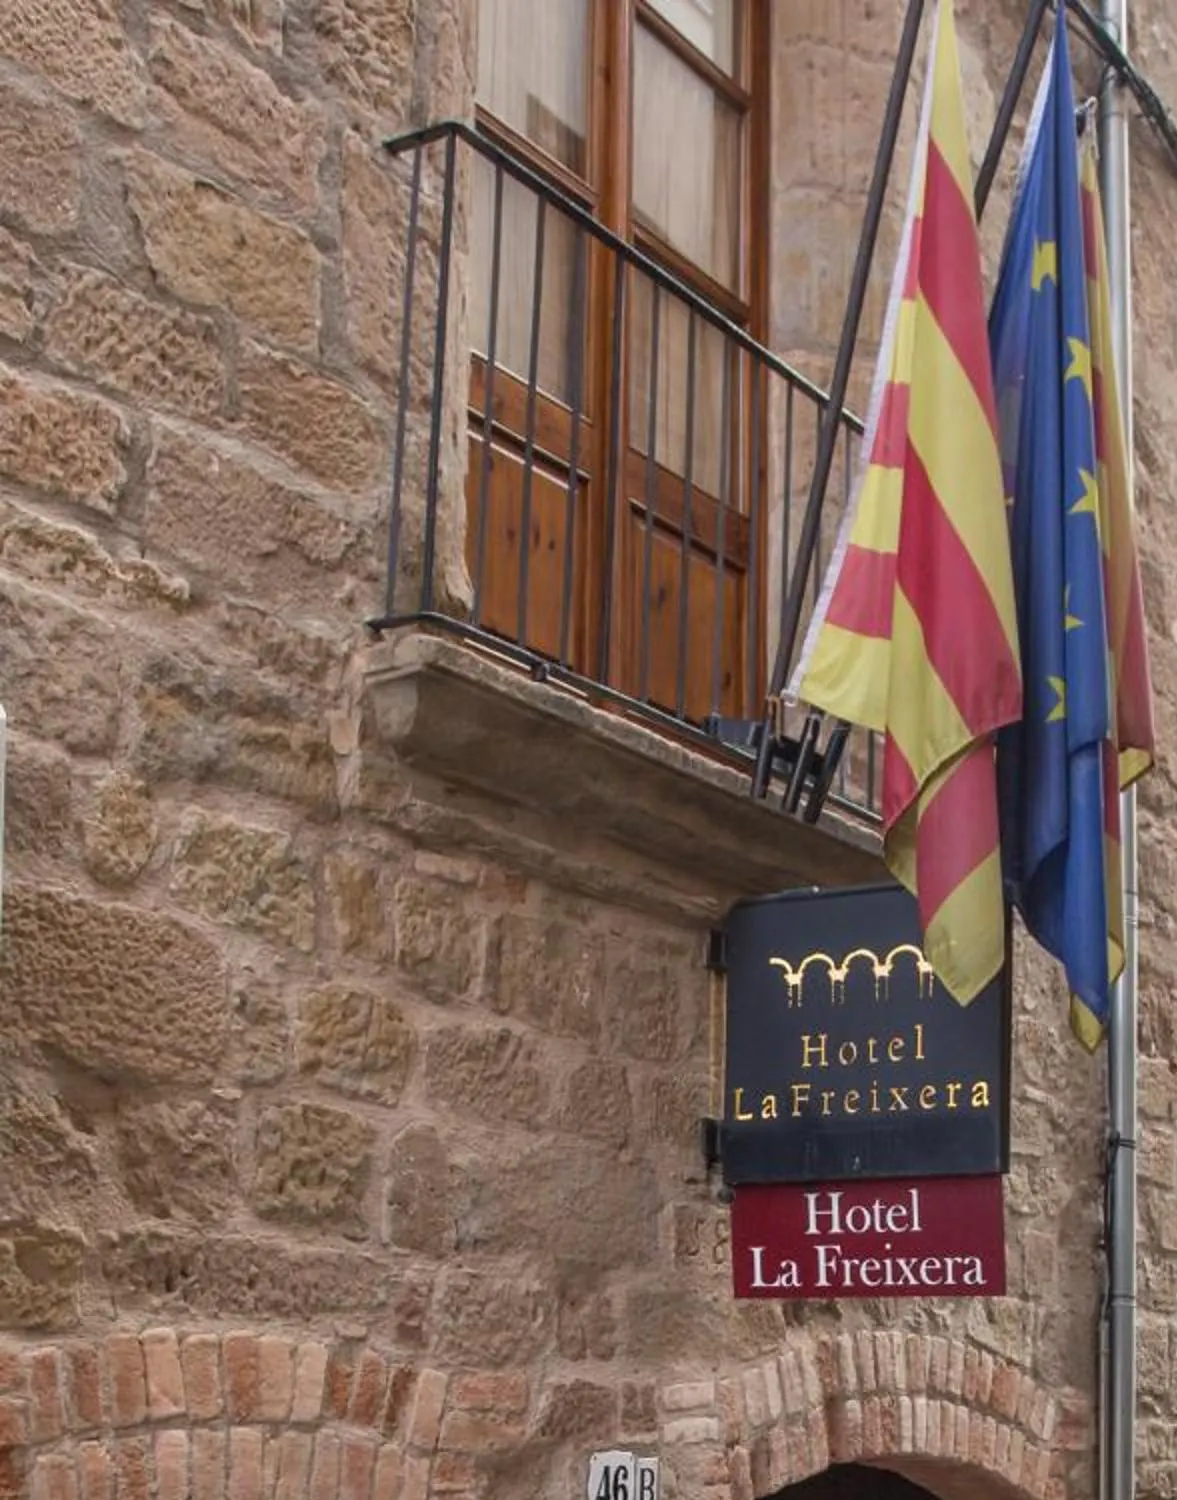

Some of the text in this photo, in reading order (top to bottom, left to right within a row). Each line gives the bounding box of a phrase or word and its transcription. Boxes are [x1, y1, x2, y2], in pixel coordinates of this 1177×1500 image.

[801, 1024, 925, 1067] Hotel
[791, 1080, 989, 1116] Freixera
[805, 1189, 921, 1234] Hotel
[750, 1243, 986, 1286] La Freixera
